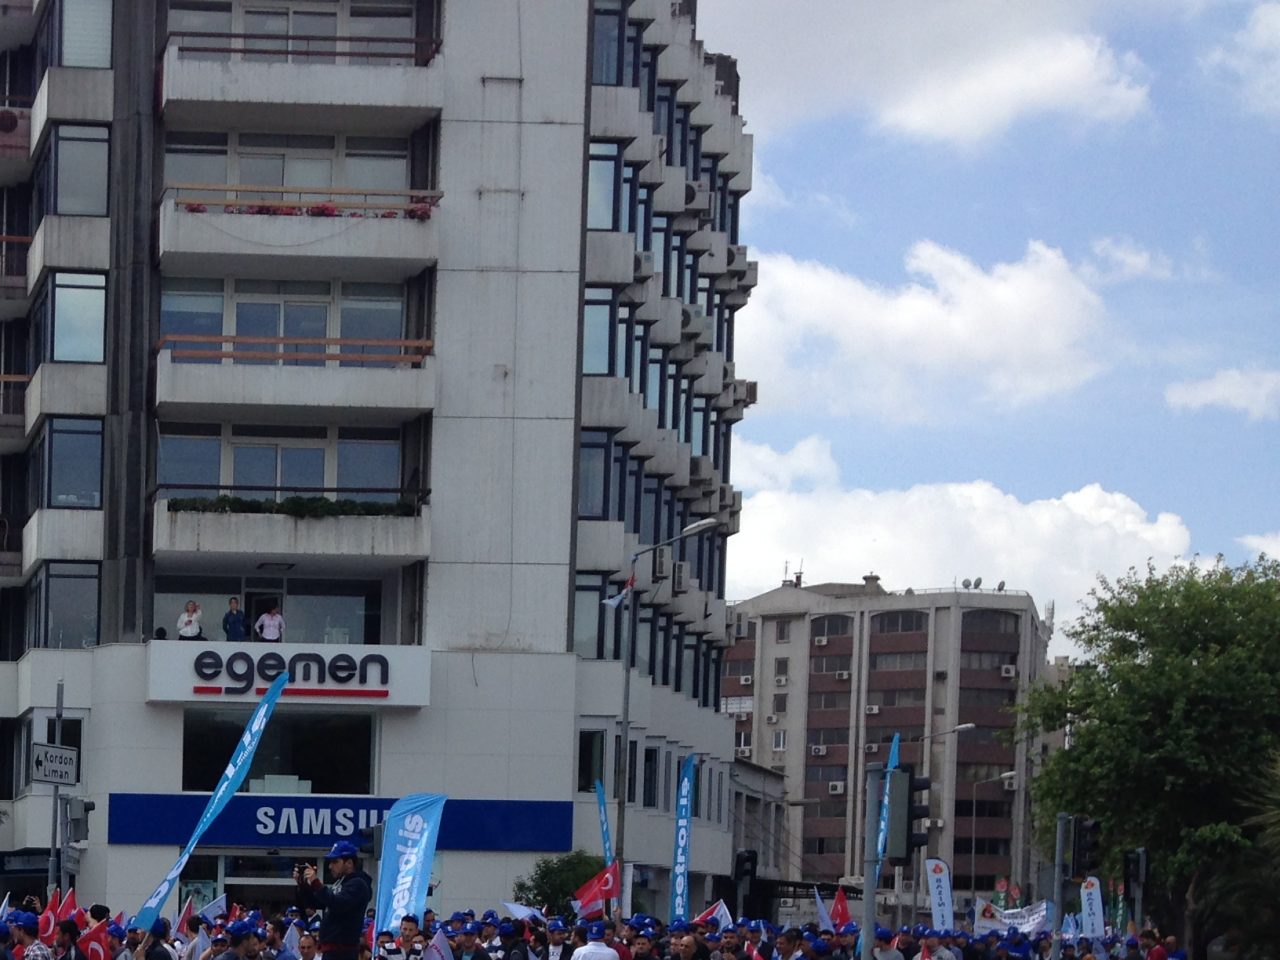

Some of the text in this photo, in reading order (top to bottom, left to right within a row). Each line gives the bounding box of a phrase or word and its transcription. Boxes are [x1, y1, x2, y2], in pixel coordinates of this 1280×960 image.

[194, 650, 389, 695] egemen
[44, 751, 74, 766] Kordon
[255, 805, 390, 836] SAMSU
